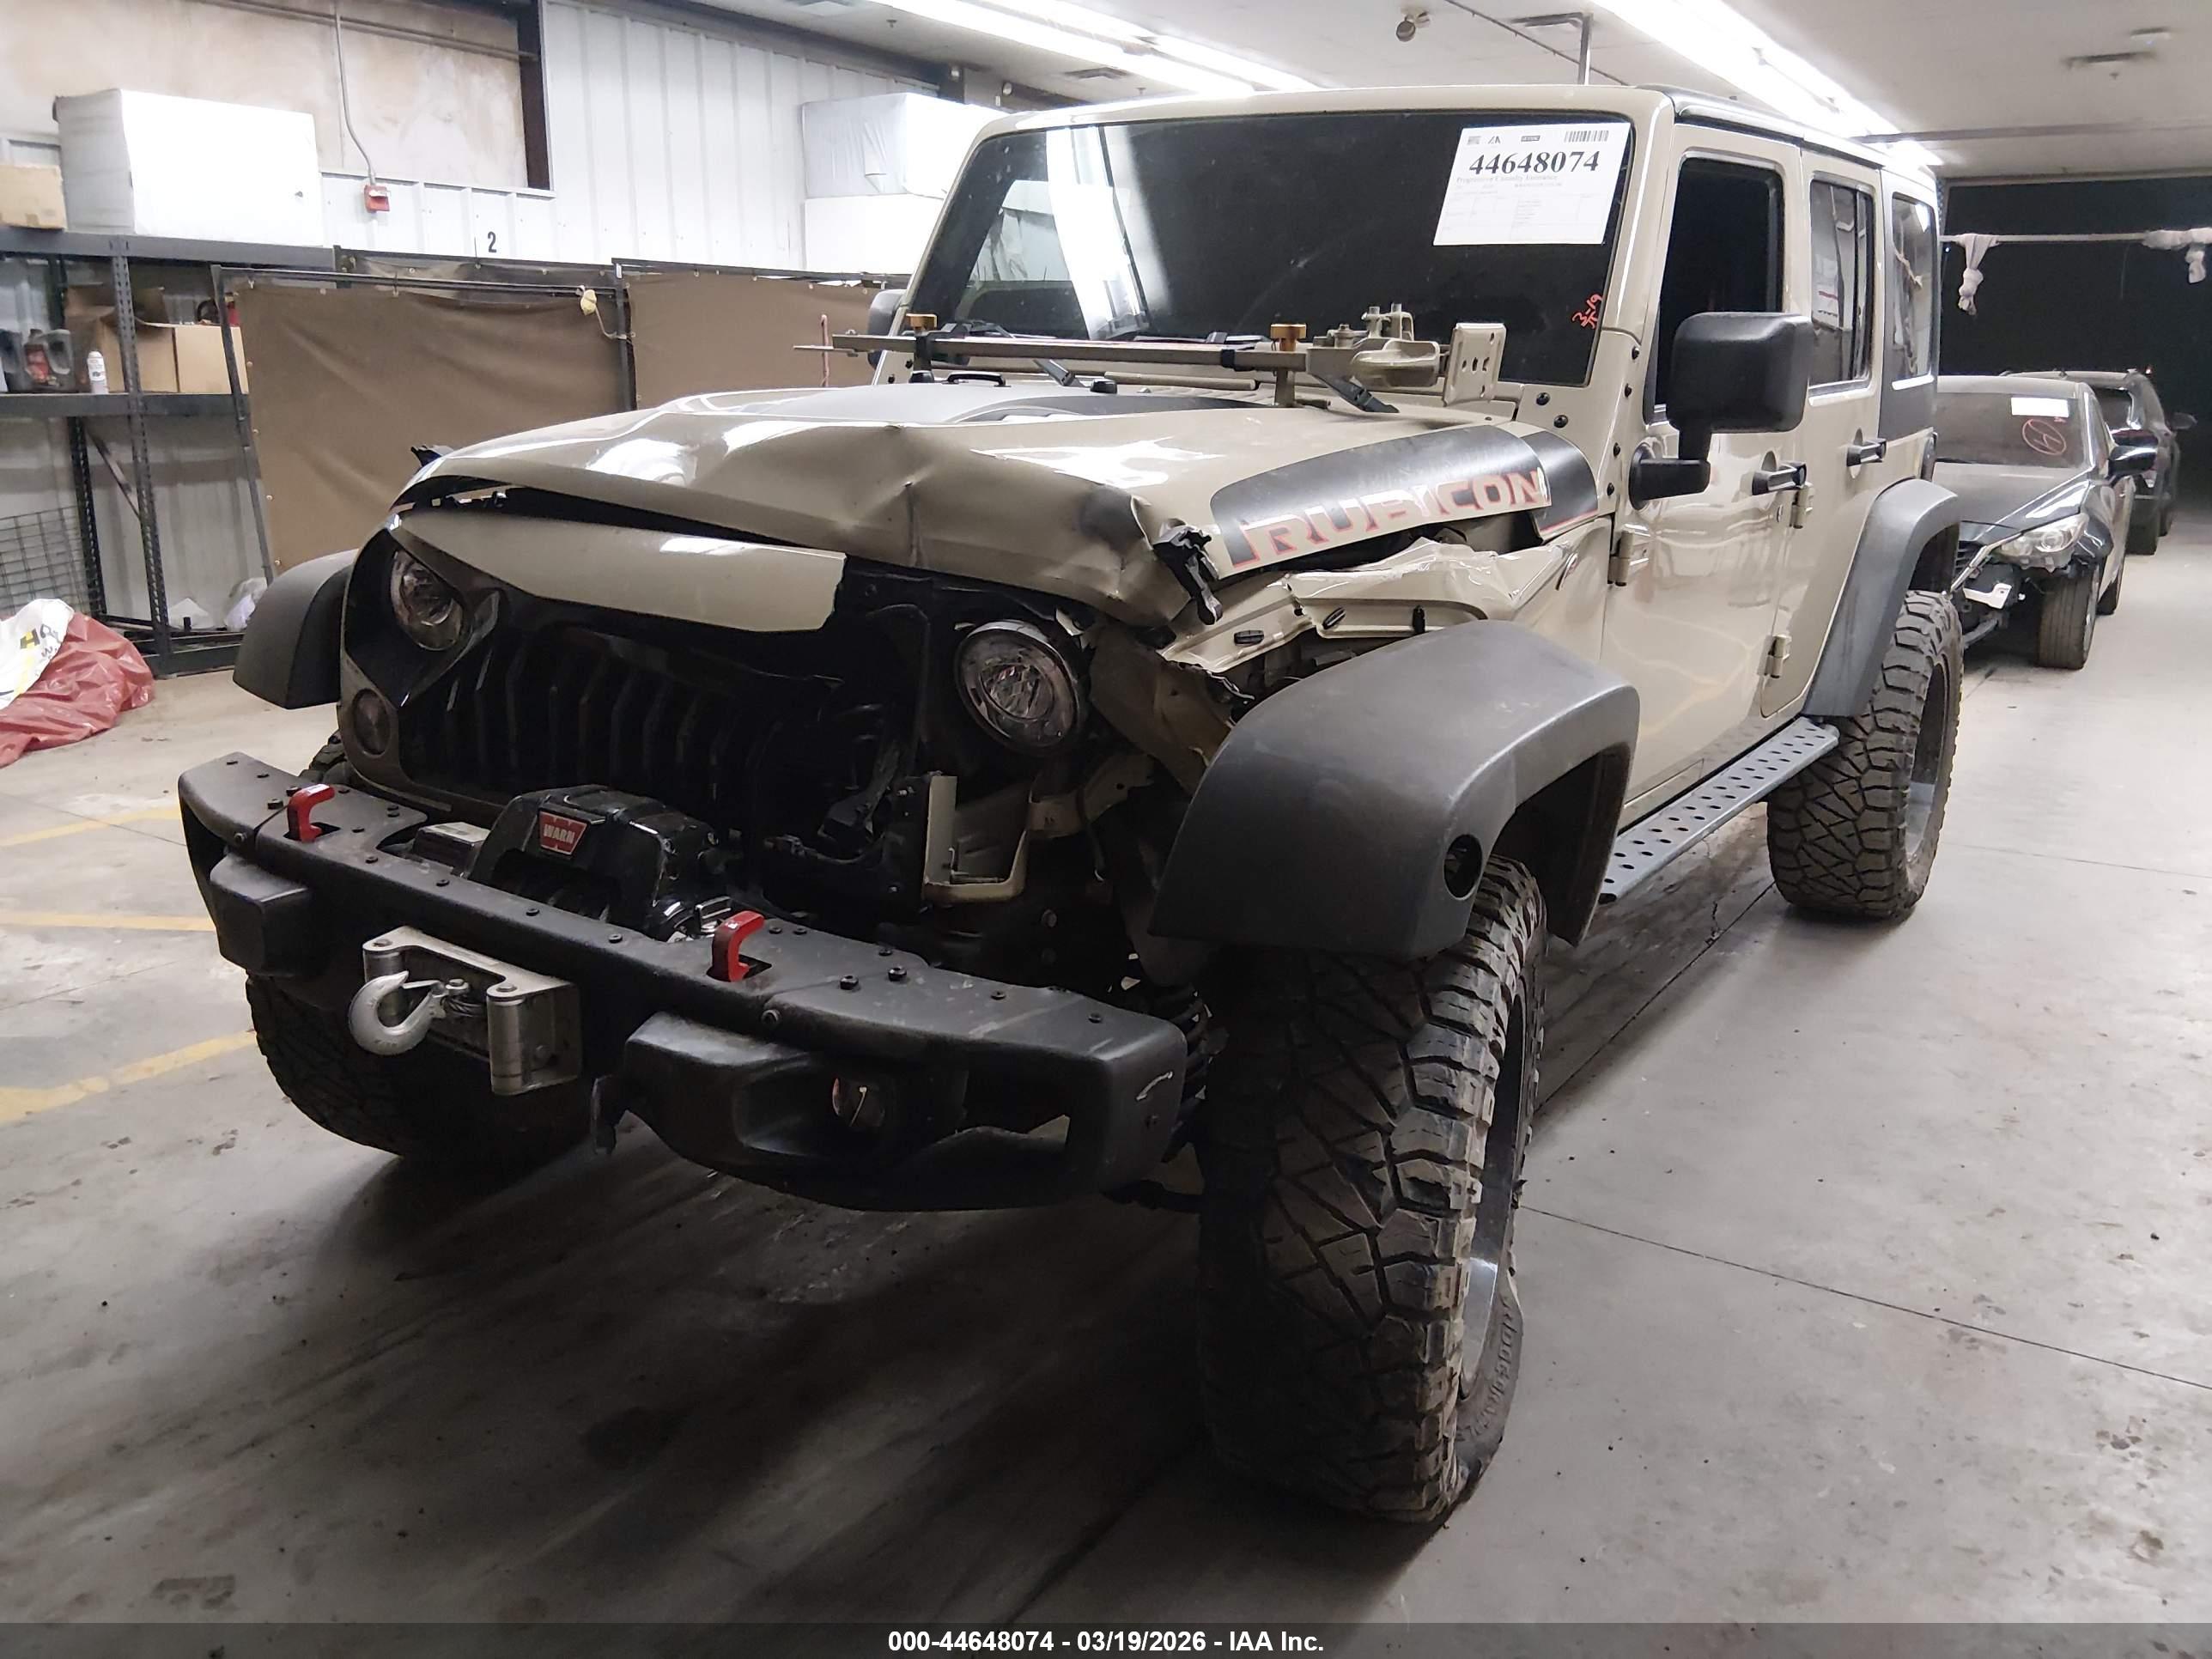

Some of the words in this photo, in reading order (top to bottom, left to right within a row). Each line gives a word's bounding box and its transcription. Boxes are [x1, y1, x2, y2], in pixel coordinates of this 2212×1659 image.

[1468, 151, 1600, 174] 44648074
[488, 231, 497, 253] 2
[1242, 468, 1550, 558] RUBICON
[544, 823, 575, 845] WARN
